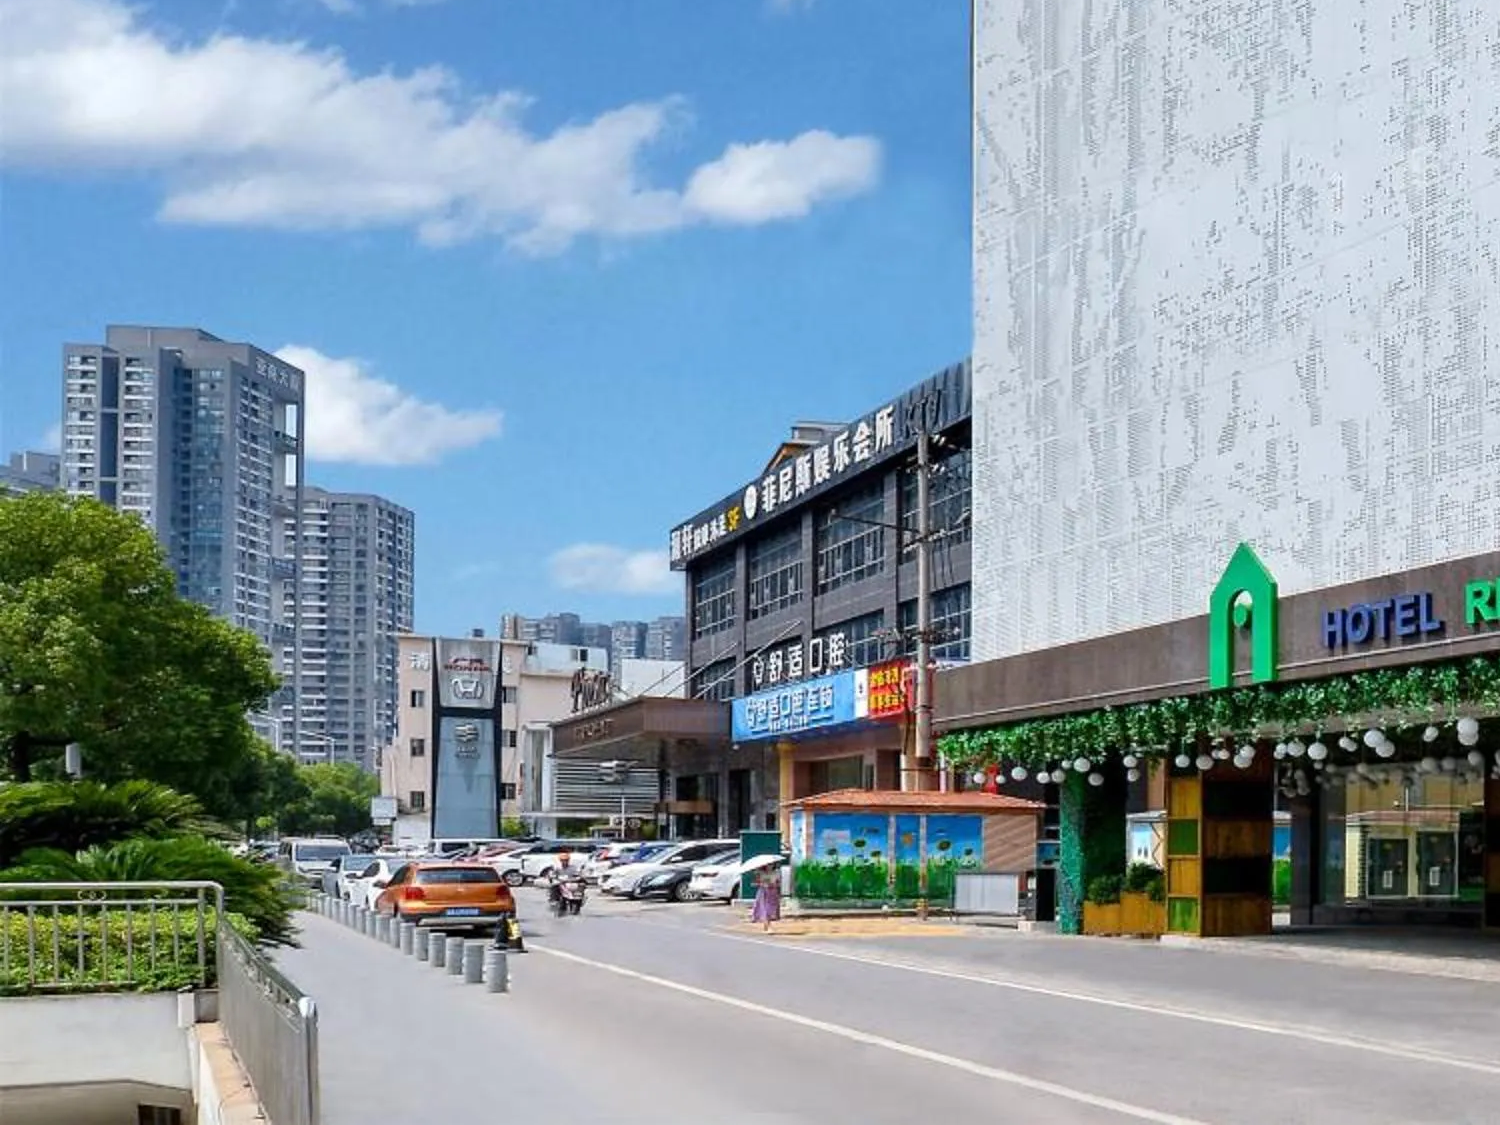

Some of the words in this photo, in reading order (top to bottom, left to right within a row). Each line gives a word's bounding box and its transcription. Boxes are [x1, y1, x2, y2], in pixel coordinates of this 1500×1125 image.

[761, 405, 895, 513] 菲尼斯娱乐会所
[1321, 591, 1443, 649] HOTEL
[768, 632, 846, 683] 舒适口腔
